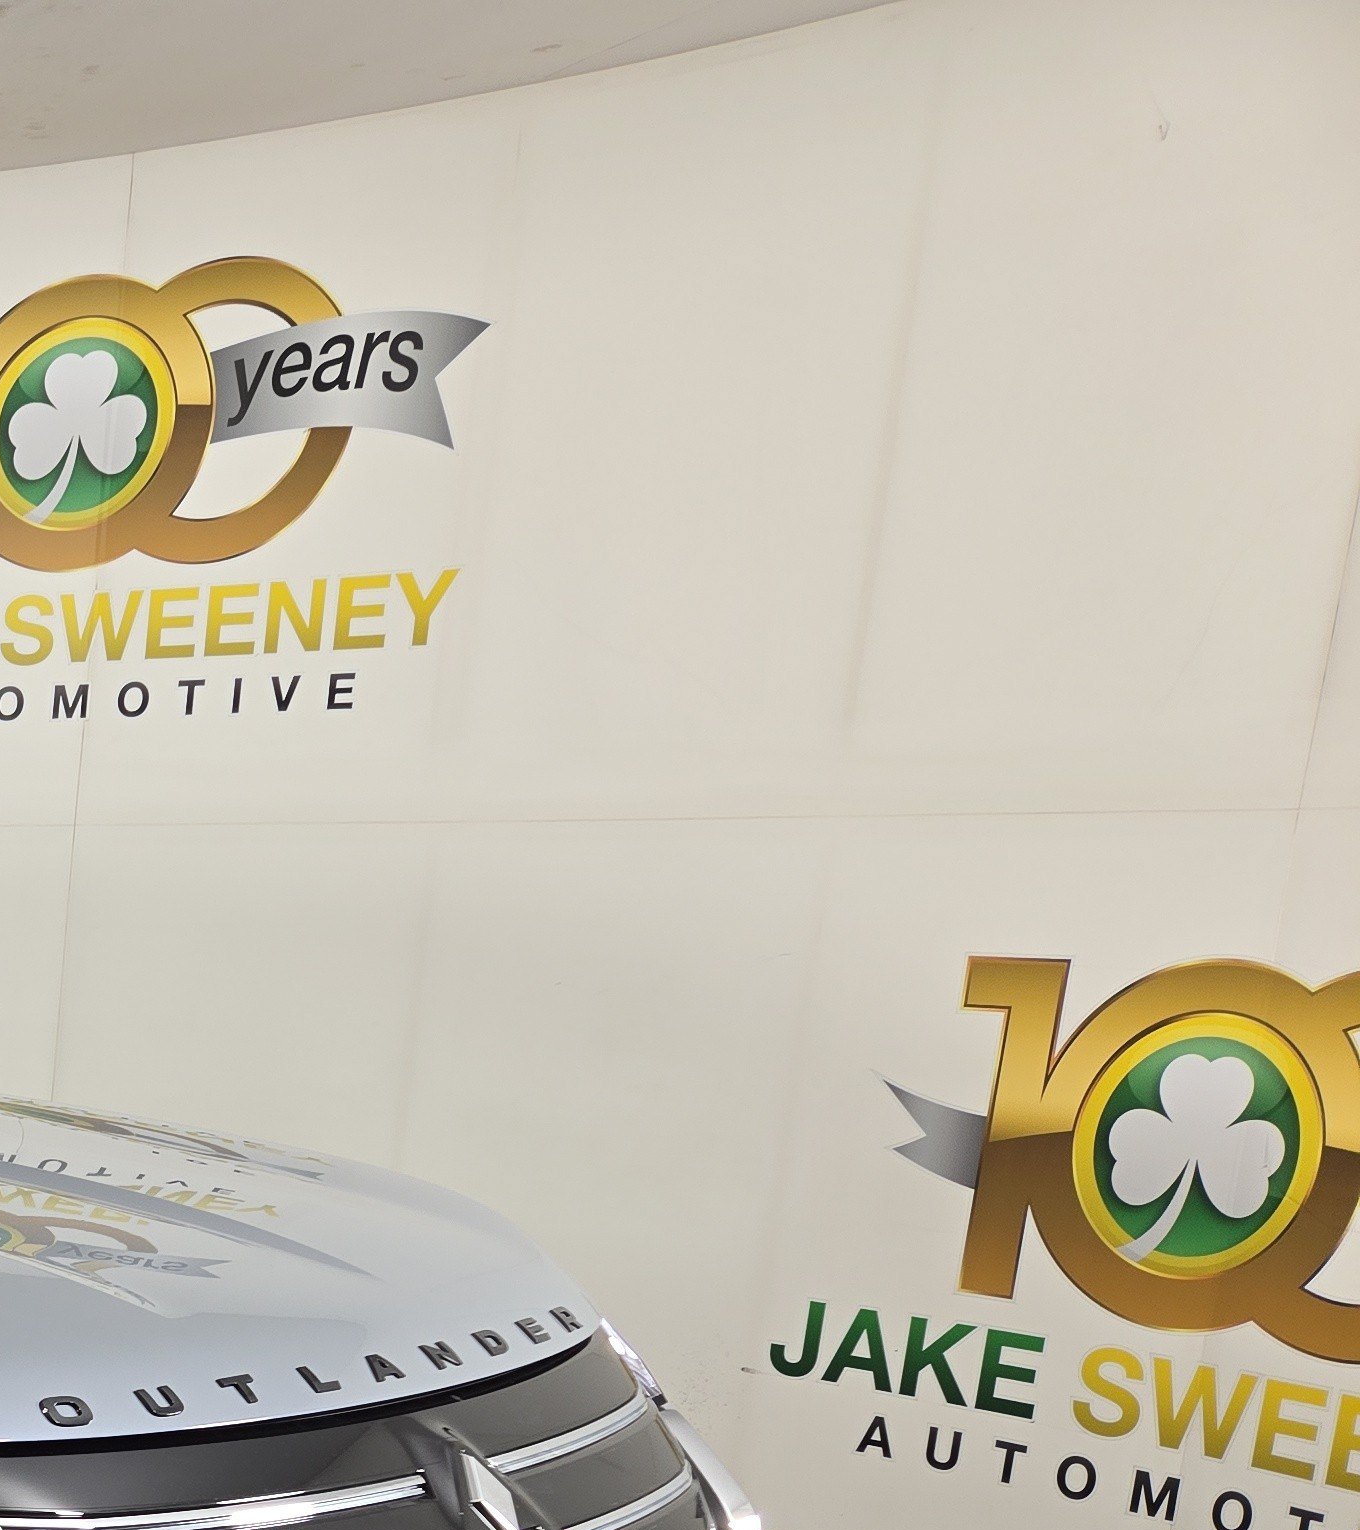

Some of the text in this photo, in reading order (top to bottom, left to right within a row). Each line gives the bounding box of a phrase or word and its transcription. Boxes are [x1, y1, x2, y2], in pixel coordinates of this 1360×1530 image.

[226, 328, 424, 427] years
[0, 567, 460, 667] SWEENEY
[957, 955, 1360, 1364] 10
[39, 1305, 584, 1427] OUTLANDER
[769, 1299, 1046, 1421] JAKE
